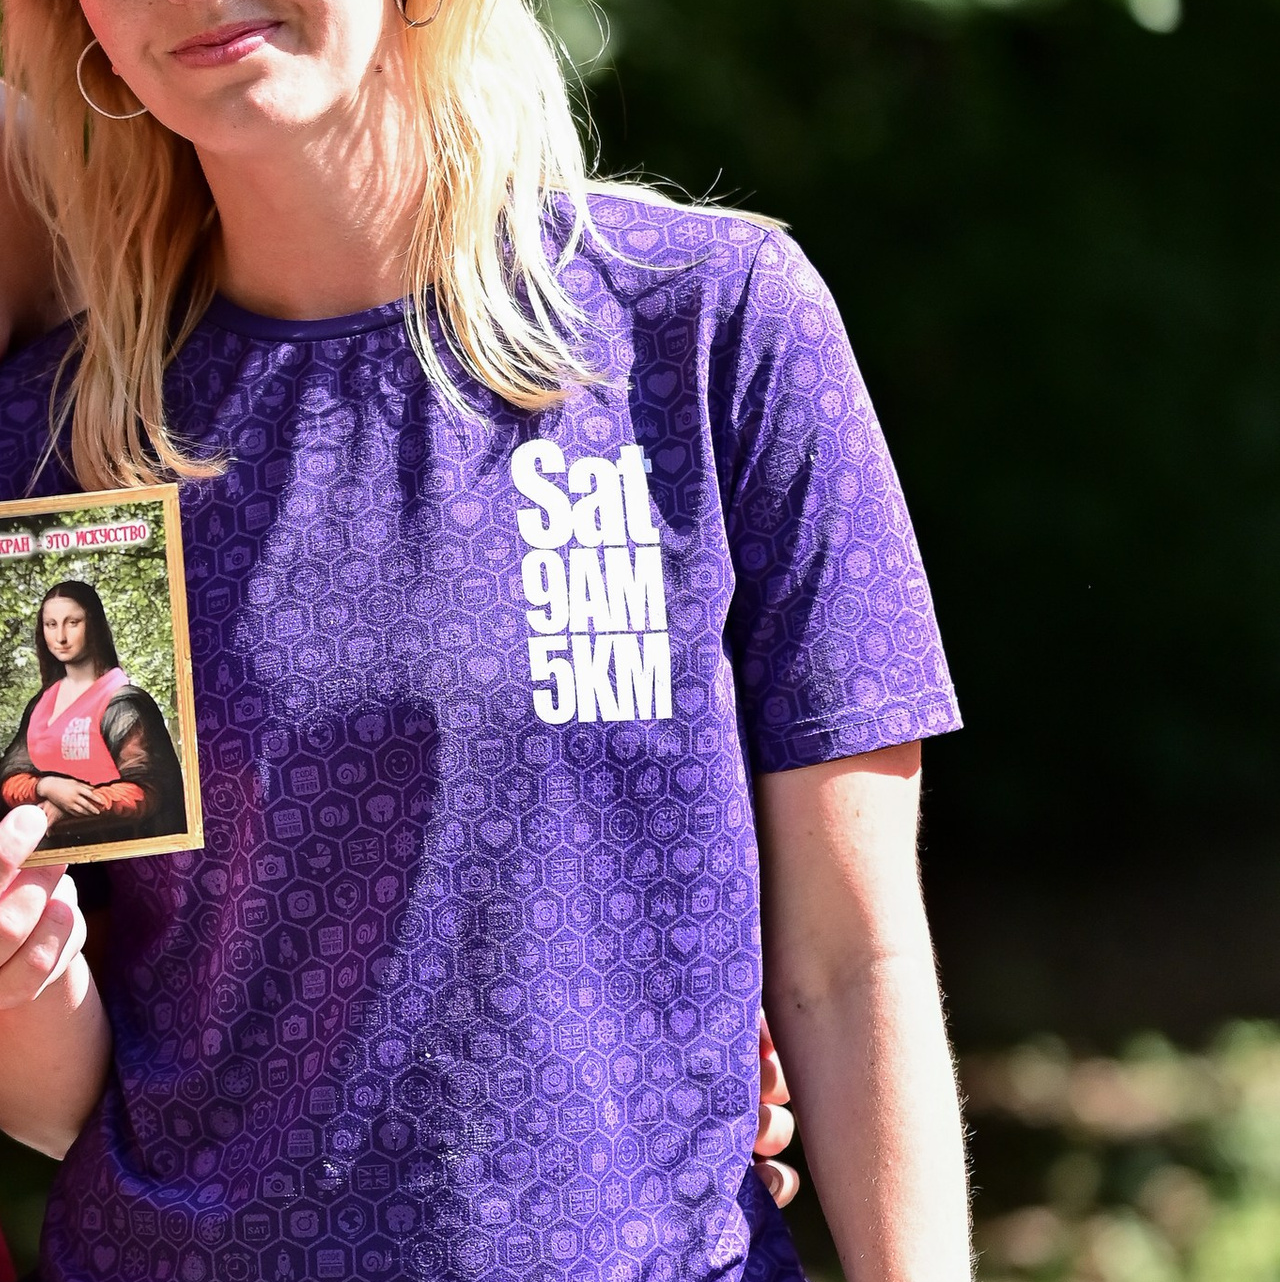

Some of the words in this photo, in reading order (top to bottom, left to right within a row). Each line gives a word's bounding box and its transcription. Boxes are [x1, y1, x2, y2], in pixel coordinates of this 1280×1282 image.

[510, 438, 660, 549] Sat
[46, 533, 70, 550] ЭТО
[76, 524, 147, 547] ИСКУССТВО
[521, 546, 668, 635] 9AM
[210, 598, 227, 609] SAT
[527, 631, 673, 725] 5KM
[224, 752, 240, 762] SAT
[295, 768, 317, 778] CODE
[277, 812, 298, 822] CODE
[247, 911, 264, 921] SAT
[271, 1071, 286, 1080] SAT
[247, 1225, 267, 1235] SAT
